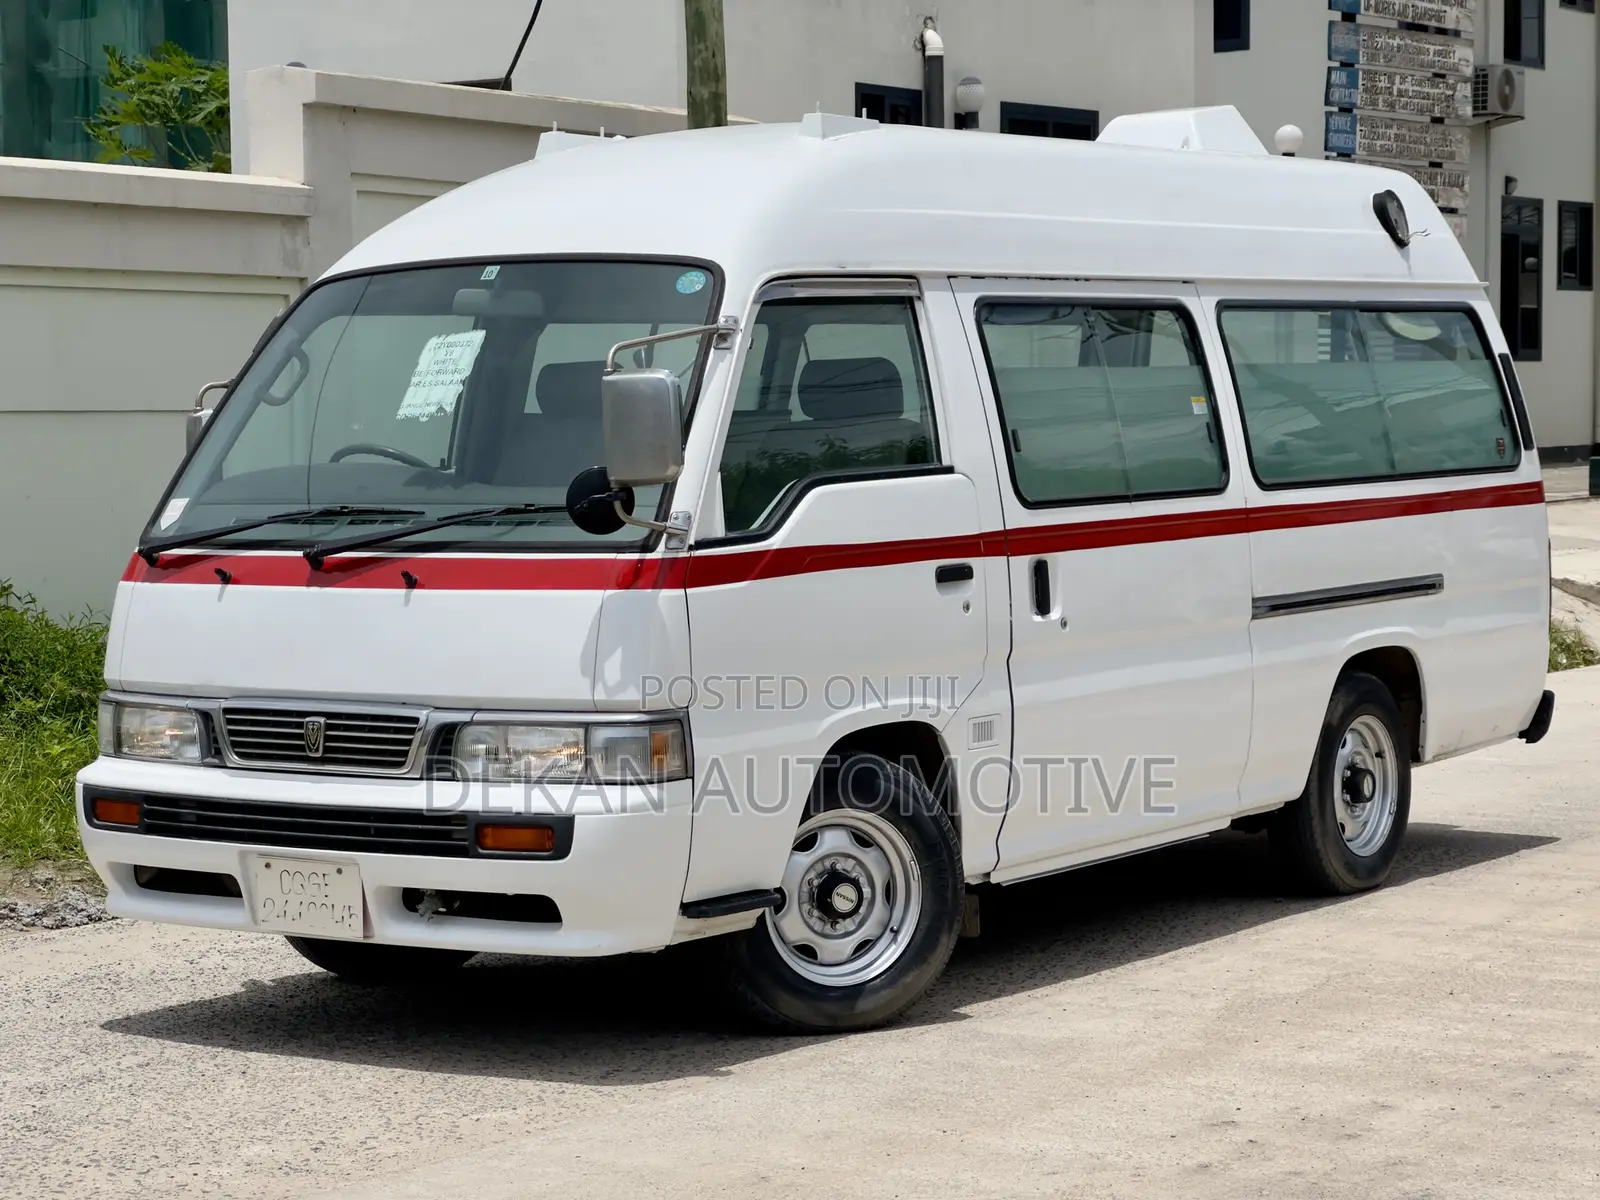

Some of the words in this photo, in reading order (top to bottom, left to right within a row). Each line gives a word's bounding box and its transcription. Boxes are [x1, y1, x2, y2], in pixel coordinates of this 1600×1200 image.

[433, 358, 457, 366] WHITE
[425, 367, 466, 378] FORWARD
[836, 891, 855, 904] NISSAN
